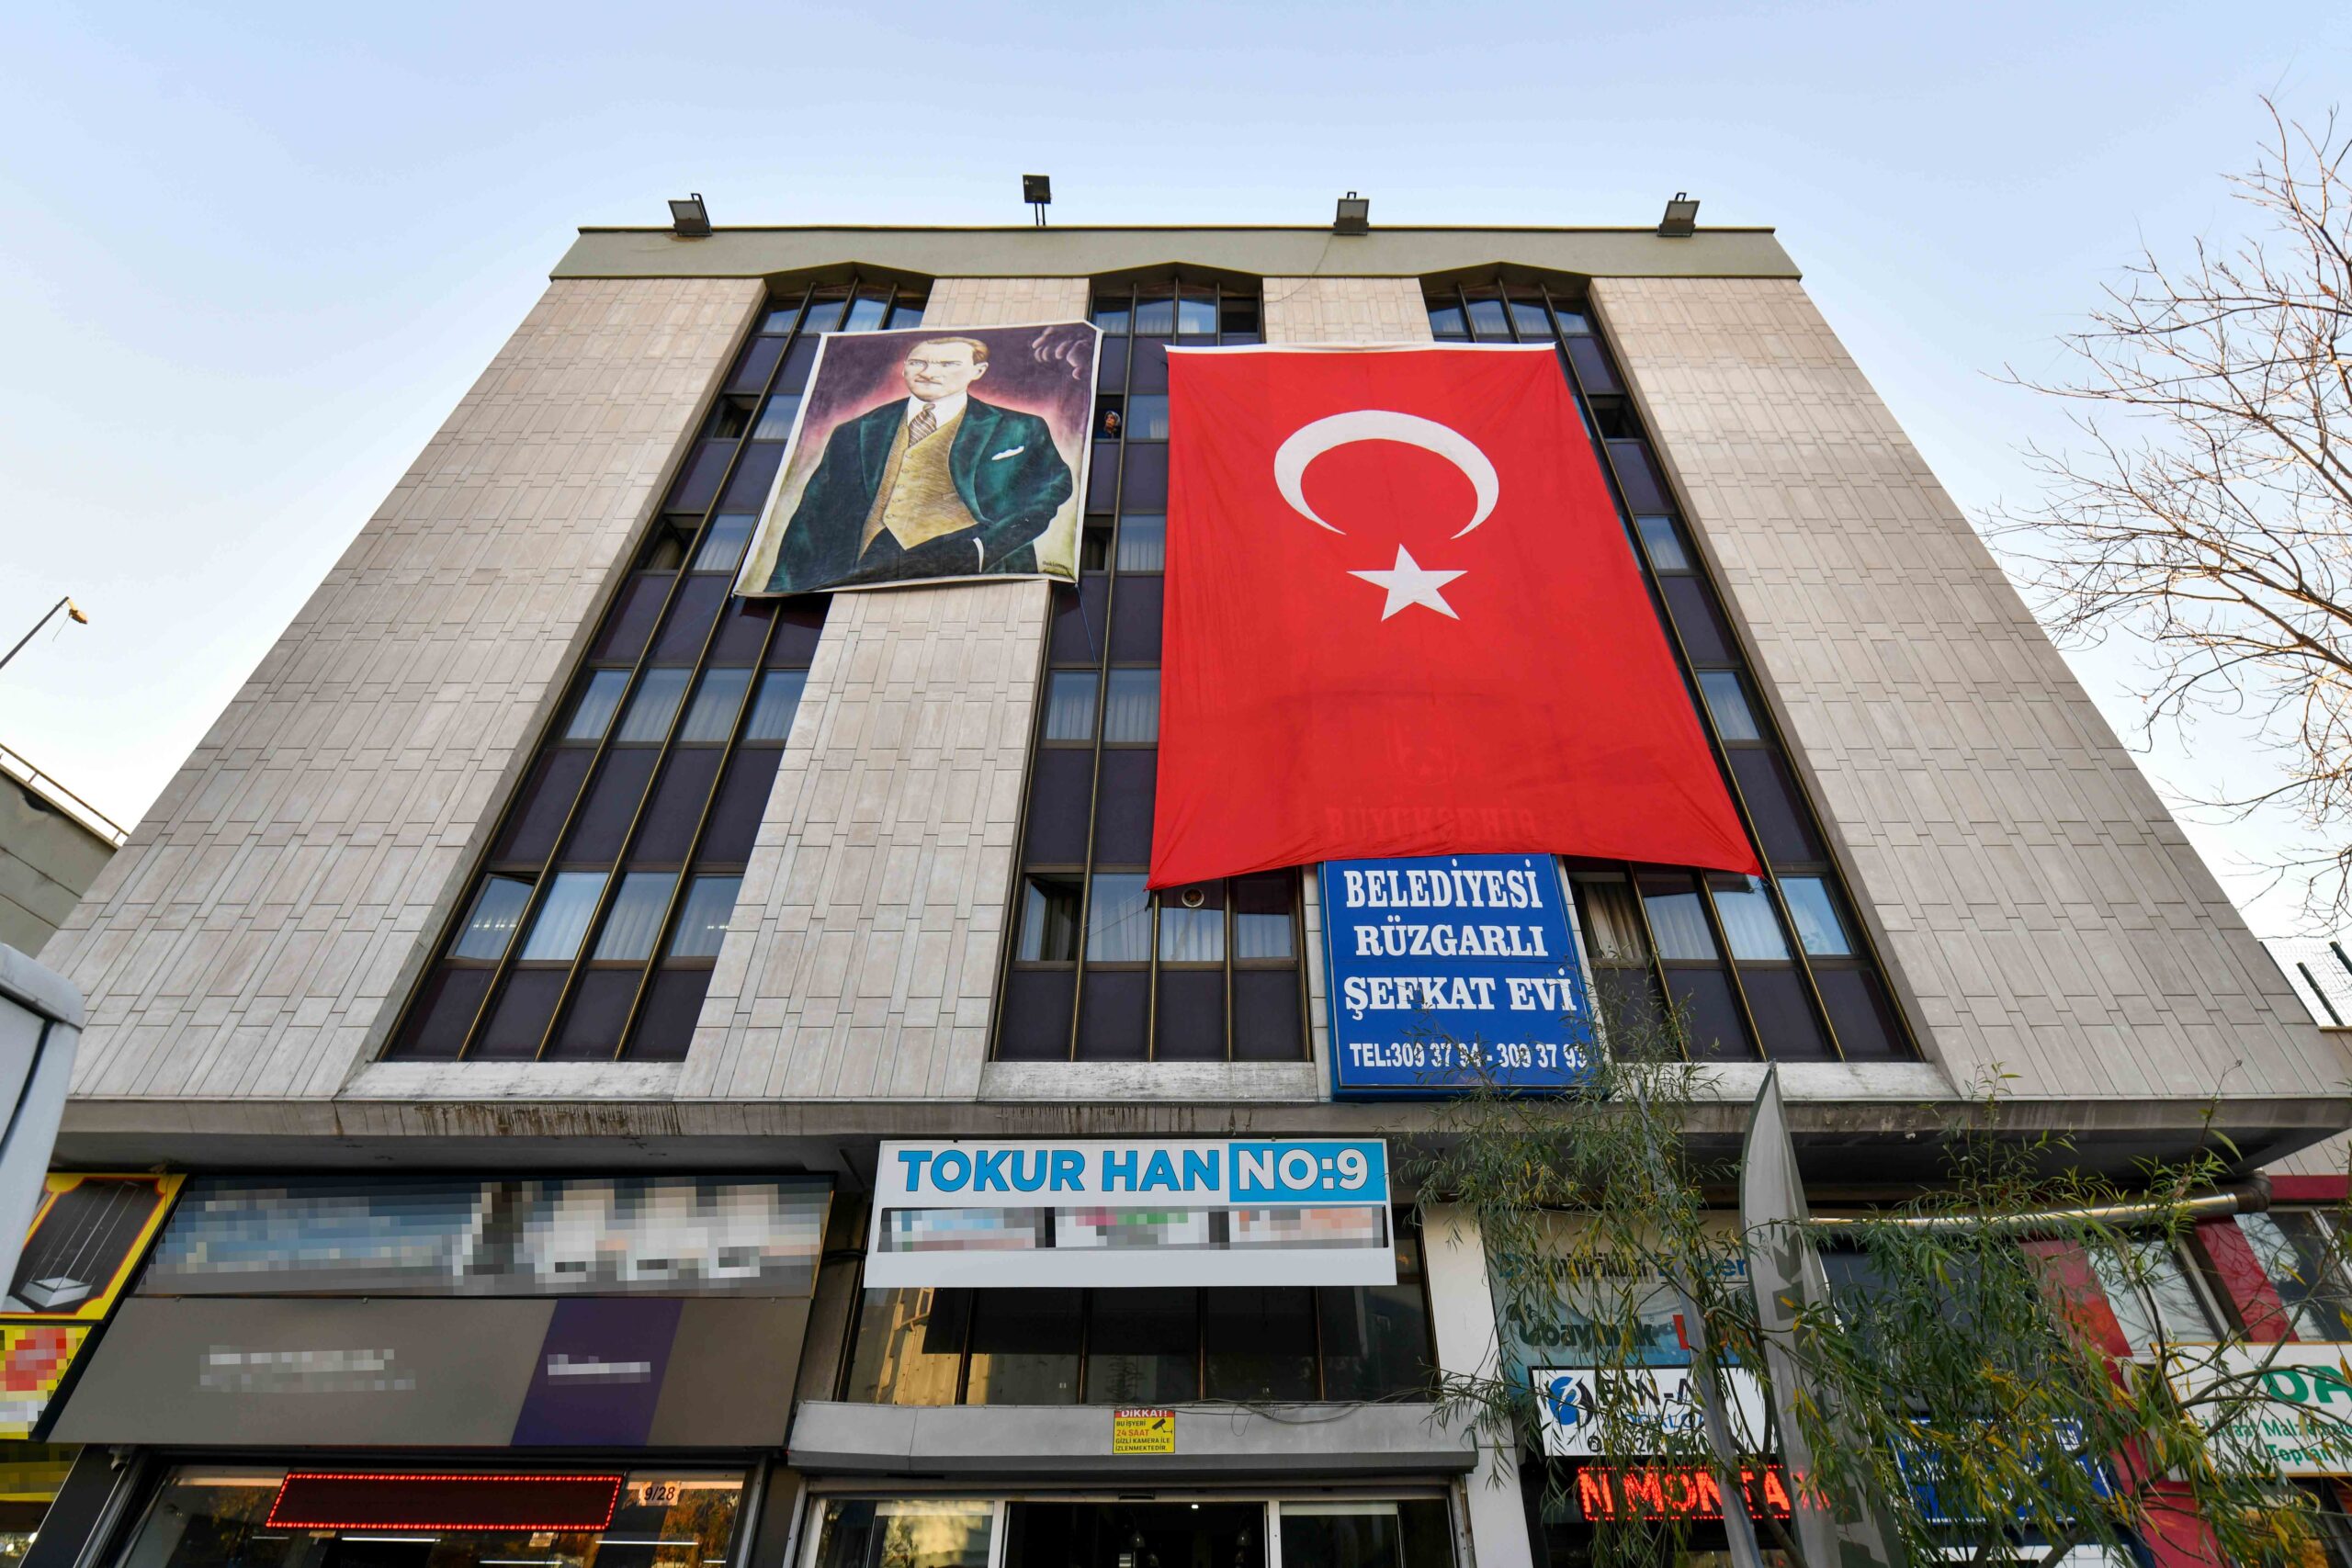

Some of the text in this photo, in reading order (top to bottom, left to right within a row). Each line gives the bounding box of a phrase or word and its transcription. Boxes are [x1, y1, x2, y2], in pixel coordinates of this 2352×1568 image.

[1344, 859, 1543, 908] BELEDİYESİ
[1354, 915, 1548, 957] RÜZGARLI
[1343, 967, 1577, 1021] ŞEFKAT EVİ
[1350, 1043, 1425, 1067] TEL:309
[1430, 1043, 1451, 1067] 37
[1497, 1043, 1532, 1068] 309
[1535, 1043, 1557, 1068] 37
[898, 1148, 1369, 1192] TOKUR HAN NO:9
[1121, 1409, 1167, 1417] DİKKAT!
[1125, 1419, 1147, 1427] İŞYERİ
[644, 1485, 675, 1501] 9/28
